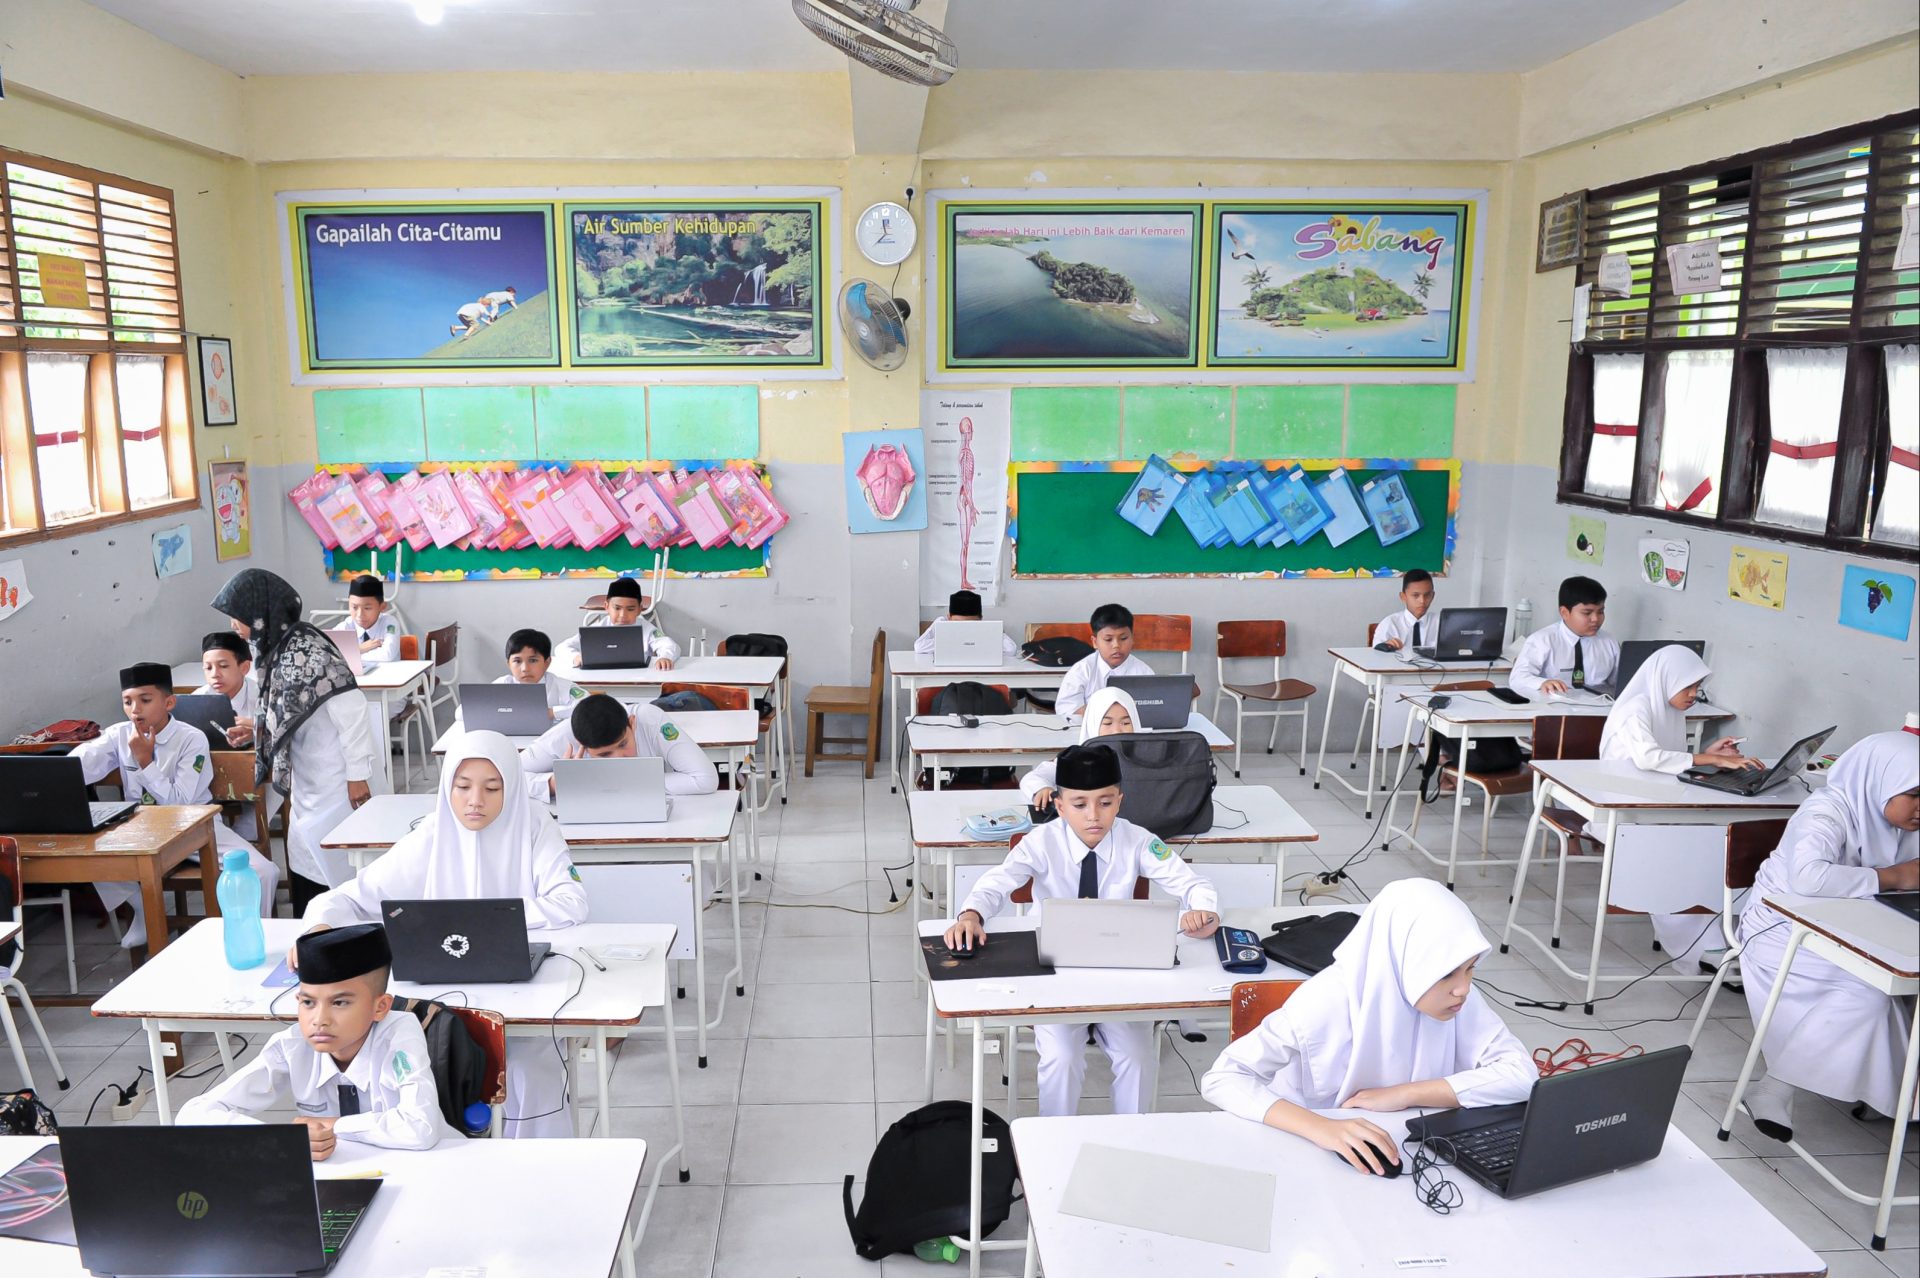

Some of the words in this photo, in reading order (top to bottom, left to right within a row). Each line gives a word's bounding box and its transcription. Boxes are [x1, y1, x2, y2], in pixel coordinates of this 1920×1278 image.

[316, 222, 392, 247] Gapailah
[397, 222, 501, 242] Cita-Citamu
[584, 218, 606, 235] Air
[611, 217, 669, 235] Sumber
[674, 217, 756, 238] Kehidupan
[1023, 226, 1044, 236] Hari
[1047, 226, 1060, 236] ini
[1063, 226, 1091, 236] Lebih
[1094, 226, 1115, 236] Baik
[1118, 226, 1138, 236] dari
[1141, 226, 1186, 236] Kemaren
[1294, 215, 1445, 270] Sabang
[1575, 1112, 1627, 1135] TOSHIBA
[182, 1191, 205, 1219] hp
